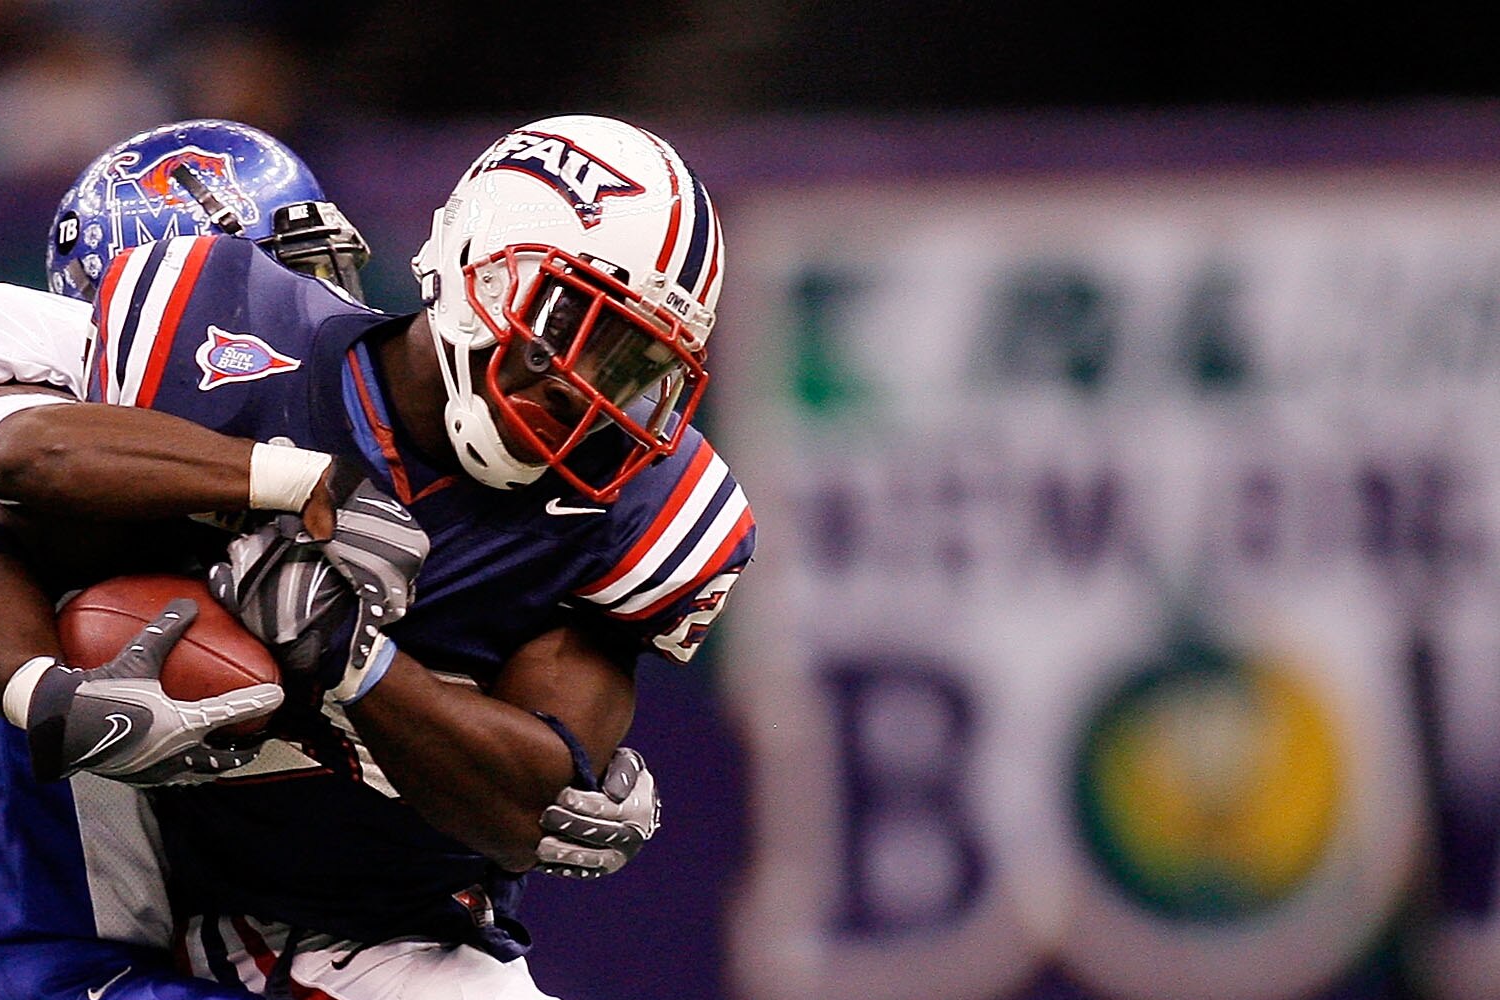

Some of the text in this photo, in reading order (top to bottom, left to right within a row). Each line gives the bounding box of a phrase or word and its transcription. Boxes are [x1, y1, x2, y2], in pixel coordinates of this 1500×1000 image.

[484, 134, 608, 205] FAU
[59, 218, 78, 244] TB
[666, 291, 691, 316] OWLS
[215, 357, 254, 371] BELT
[221, 346, 254, 362] SUN
